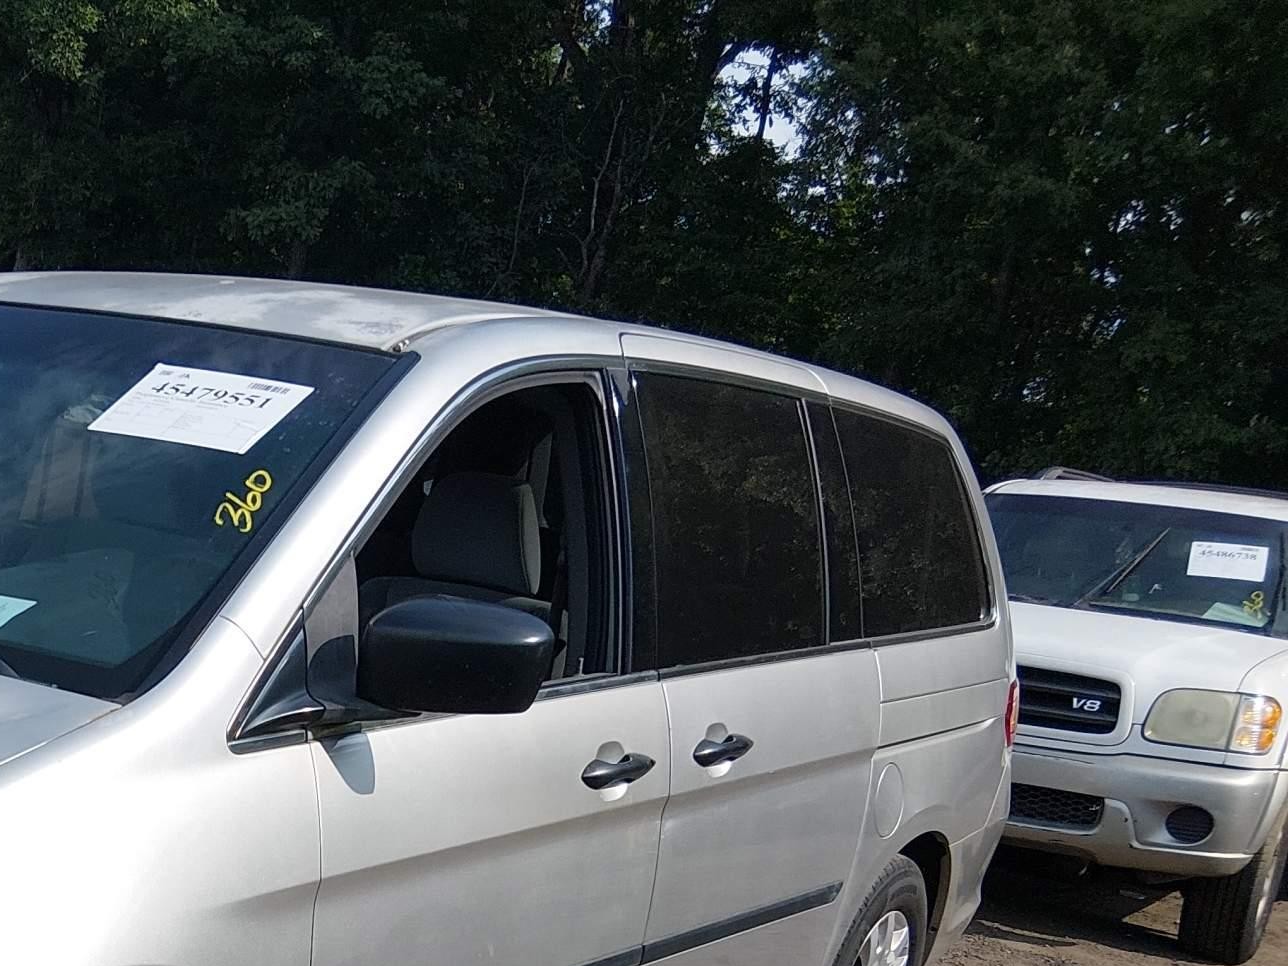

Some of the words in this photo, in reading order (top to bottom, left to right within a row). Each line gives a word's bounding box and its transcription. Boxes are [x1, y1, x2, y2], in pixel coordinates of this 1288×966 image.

[151, 382, 272, 408] 45479551
[214, 470, 272, 532] 360
[1071, 697, 1101, 712] V8
